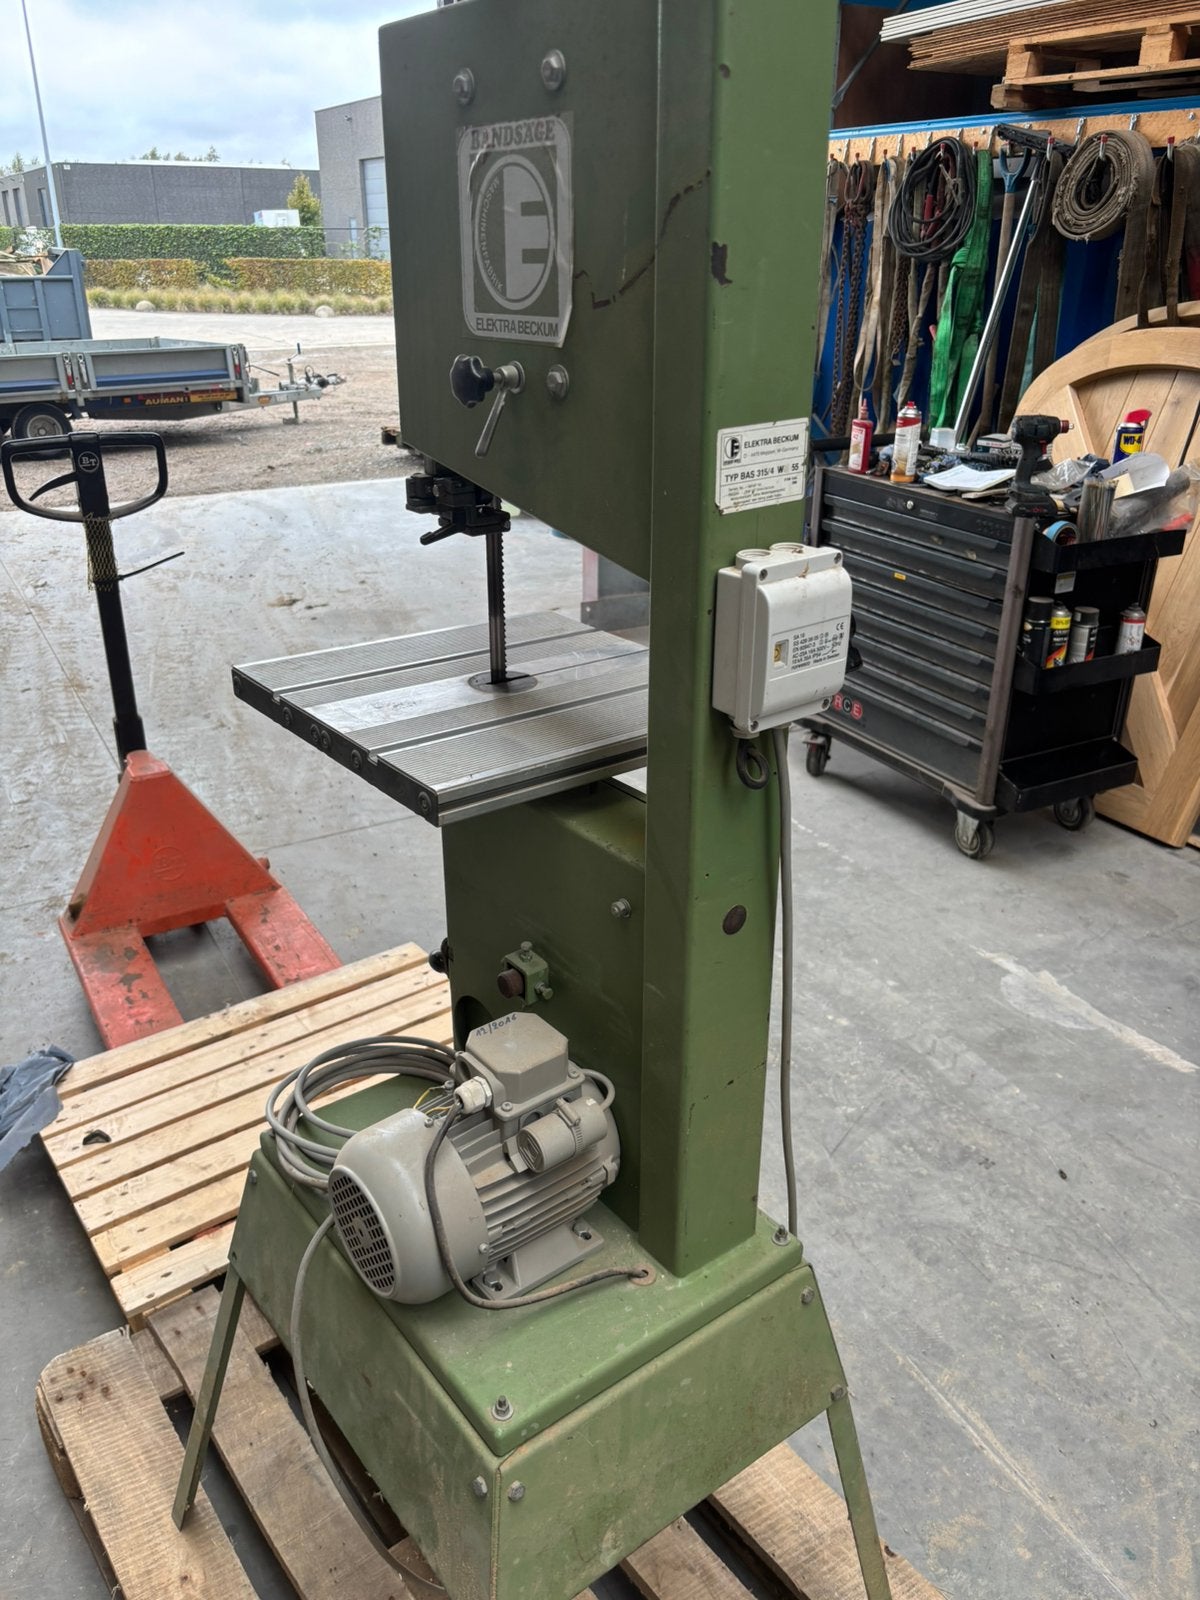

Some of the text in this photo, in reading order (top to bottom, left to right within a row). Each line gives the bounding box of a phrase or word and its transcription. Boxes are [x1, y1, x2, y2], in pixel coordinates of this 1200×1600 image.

[475, 316, 559, 338] ELEKTRA BECKUM
[744, 434, 799, 449] ELEKTRA BECKUM
[1123, 435, 1142, 445] WD-4
[725, 463, 800, 483] TYP BAS 315/4 W 55
